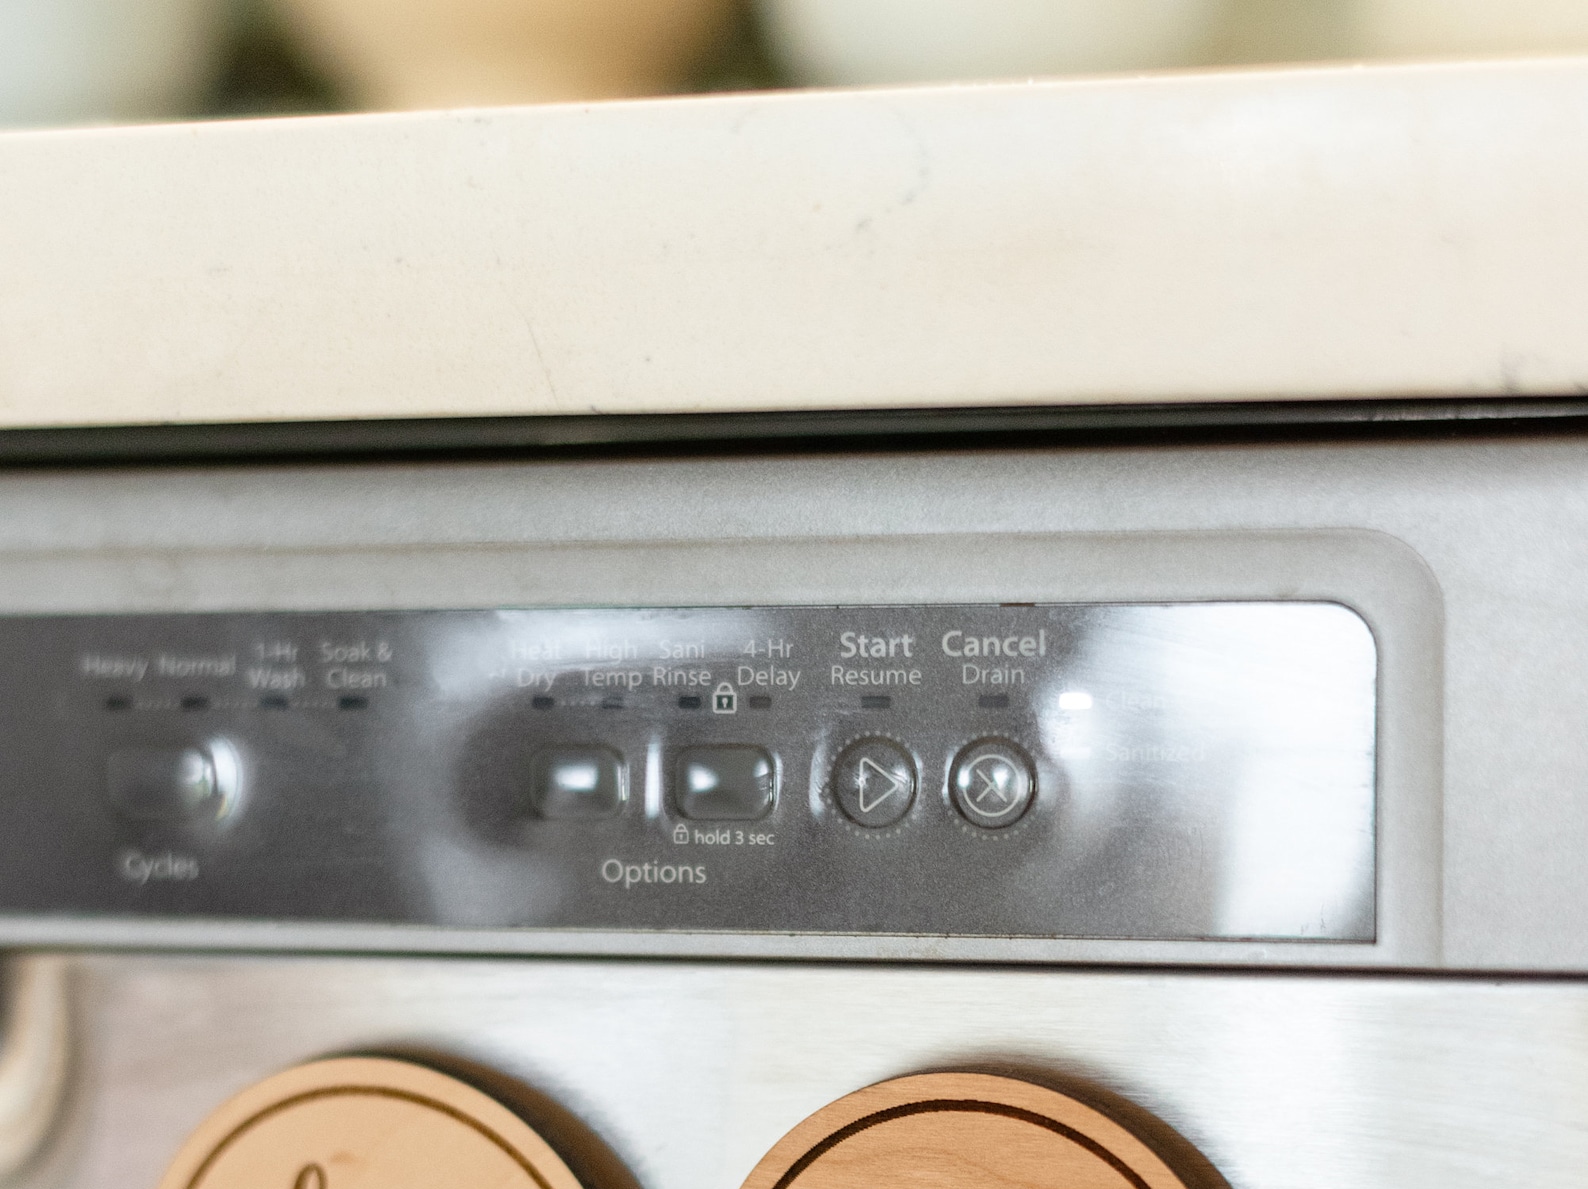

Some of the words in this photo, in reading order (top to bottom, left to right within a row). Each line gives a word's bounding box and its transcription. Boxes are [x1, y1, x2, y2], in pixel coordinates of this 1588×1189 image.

[319, 641, 370, 663] Soak
[377, 640, 393, 663] &
[659, 639, 705, 660] Sani
[741, 639, 795, 660] 4-Hr
[840, 631, 914, 660] Start
[941, 630, 1047, 659] Cancel
[248, 668, 305, 689] Wash
[326, 668, 388, 689] Clean
[517, 667, 557, 692] Dry
[582, 668, 643, 691] Temp
[653, 666, 712, 687] Rinse
[737, 665, 801, 692] Delay
[830, 665, 922, 687] Resume
[961, 664, 1026, 686] Drain
[694, 829, 731, 846] hold
[735, 831, 745, 846] 3
[748, 832, 776, 846] sec
[119, 851, 199, 885] Cycles
[601, 858, 707, 889] Options
